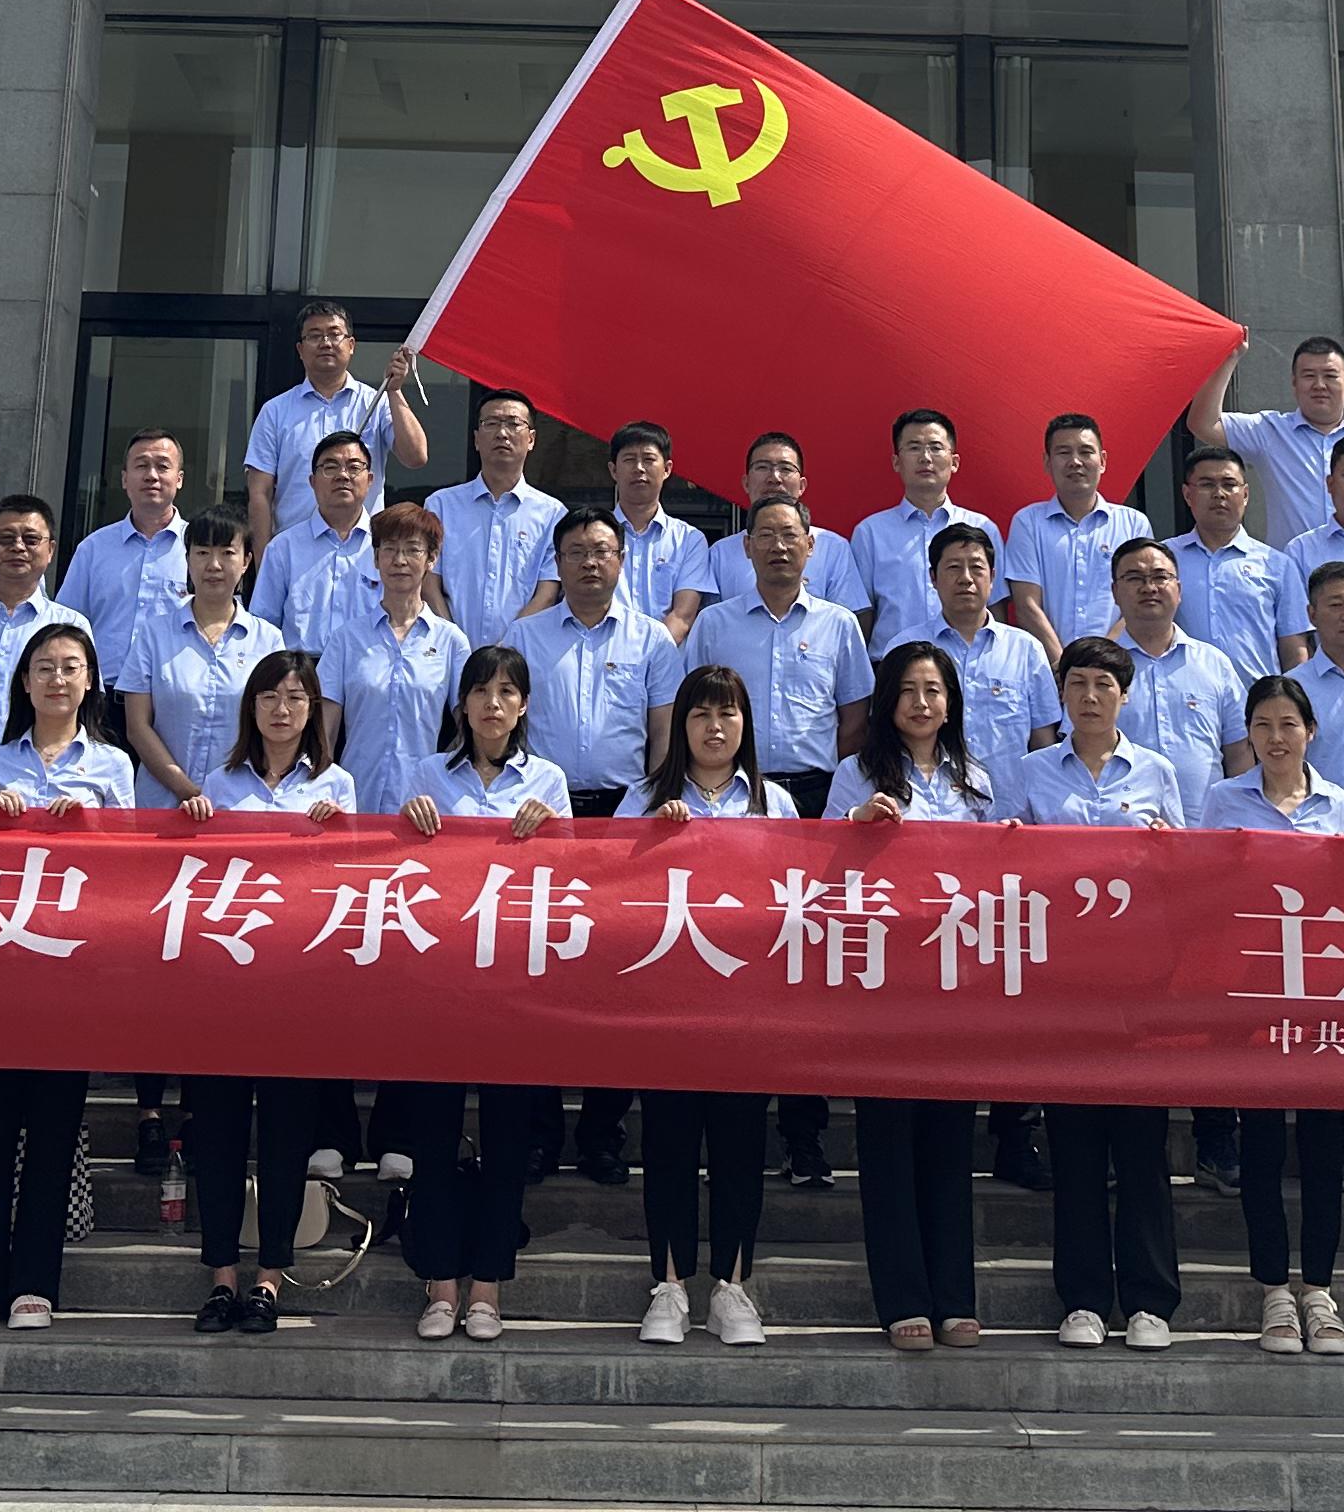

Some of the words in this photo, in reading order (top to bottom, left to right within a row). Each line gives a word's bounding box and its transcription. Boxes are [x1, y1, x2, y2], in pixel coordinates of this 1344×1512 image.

[149, 853, 1134, 998] 传承伟大精神”
